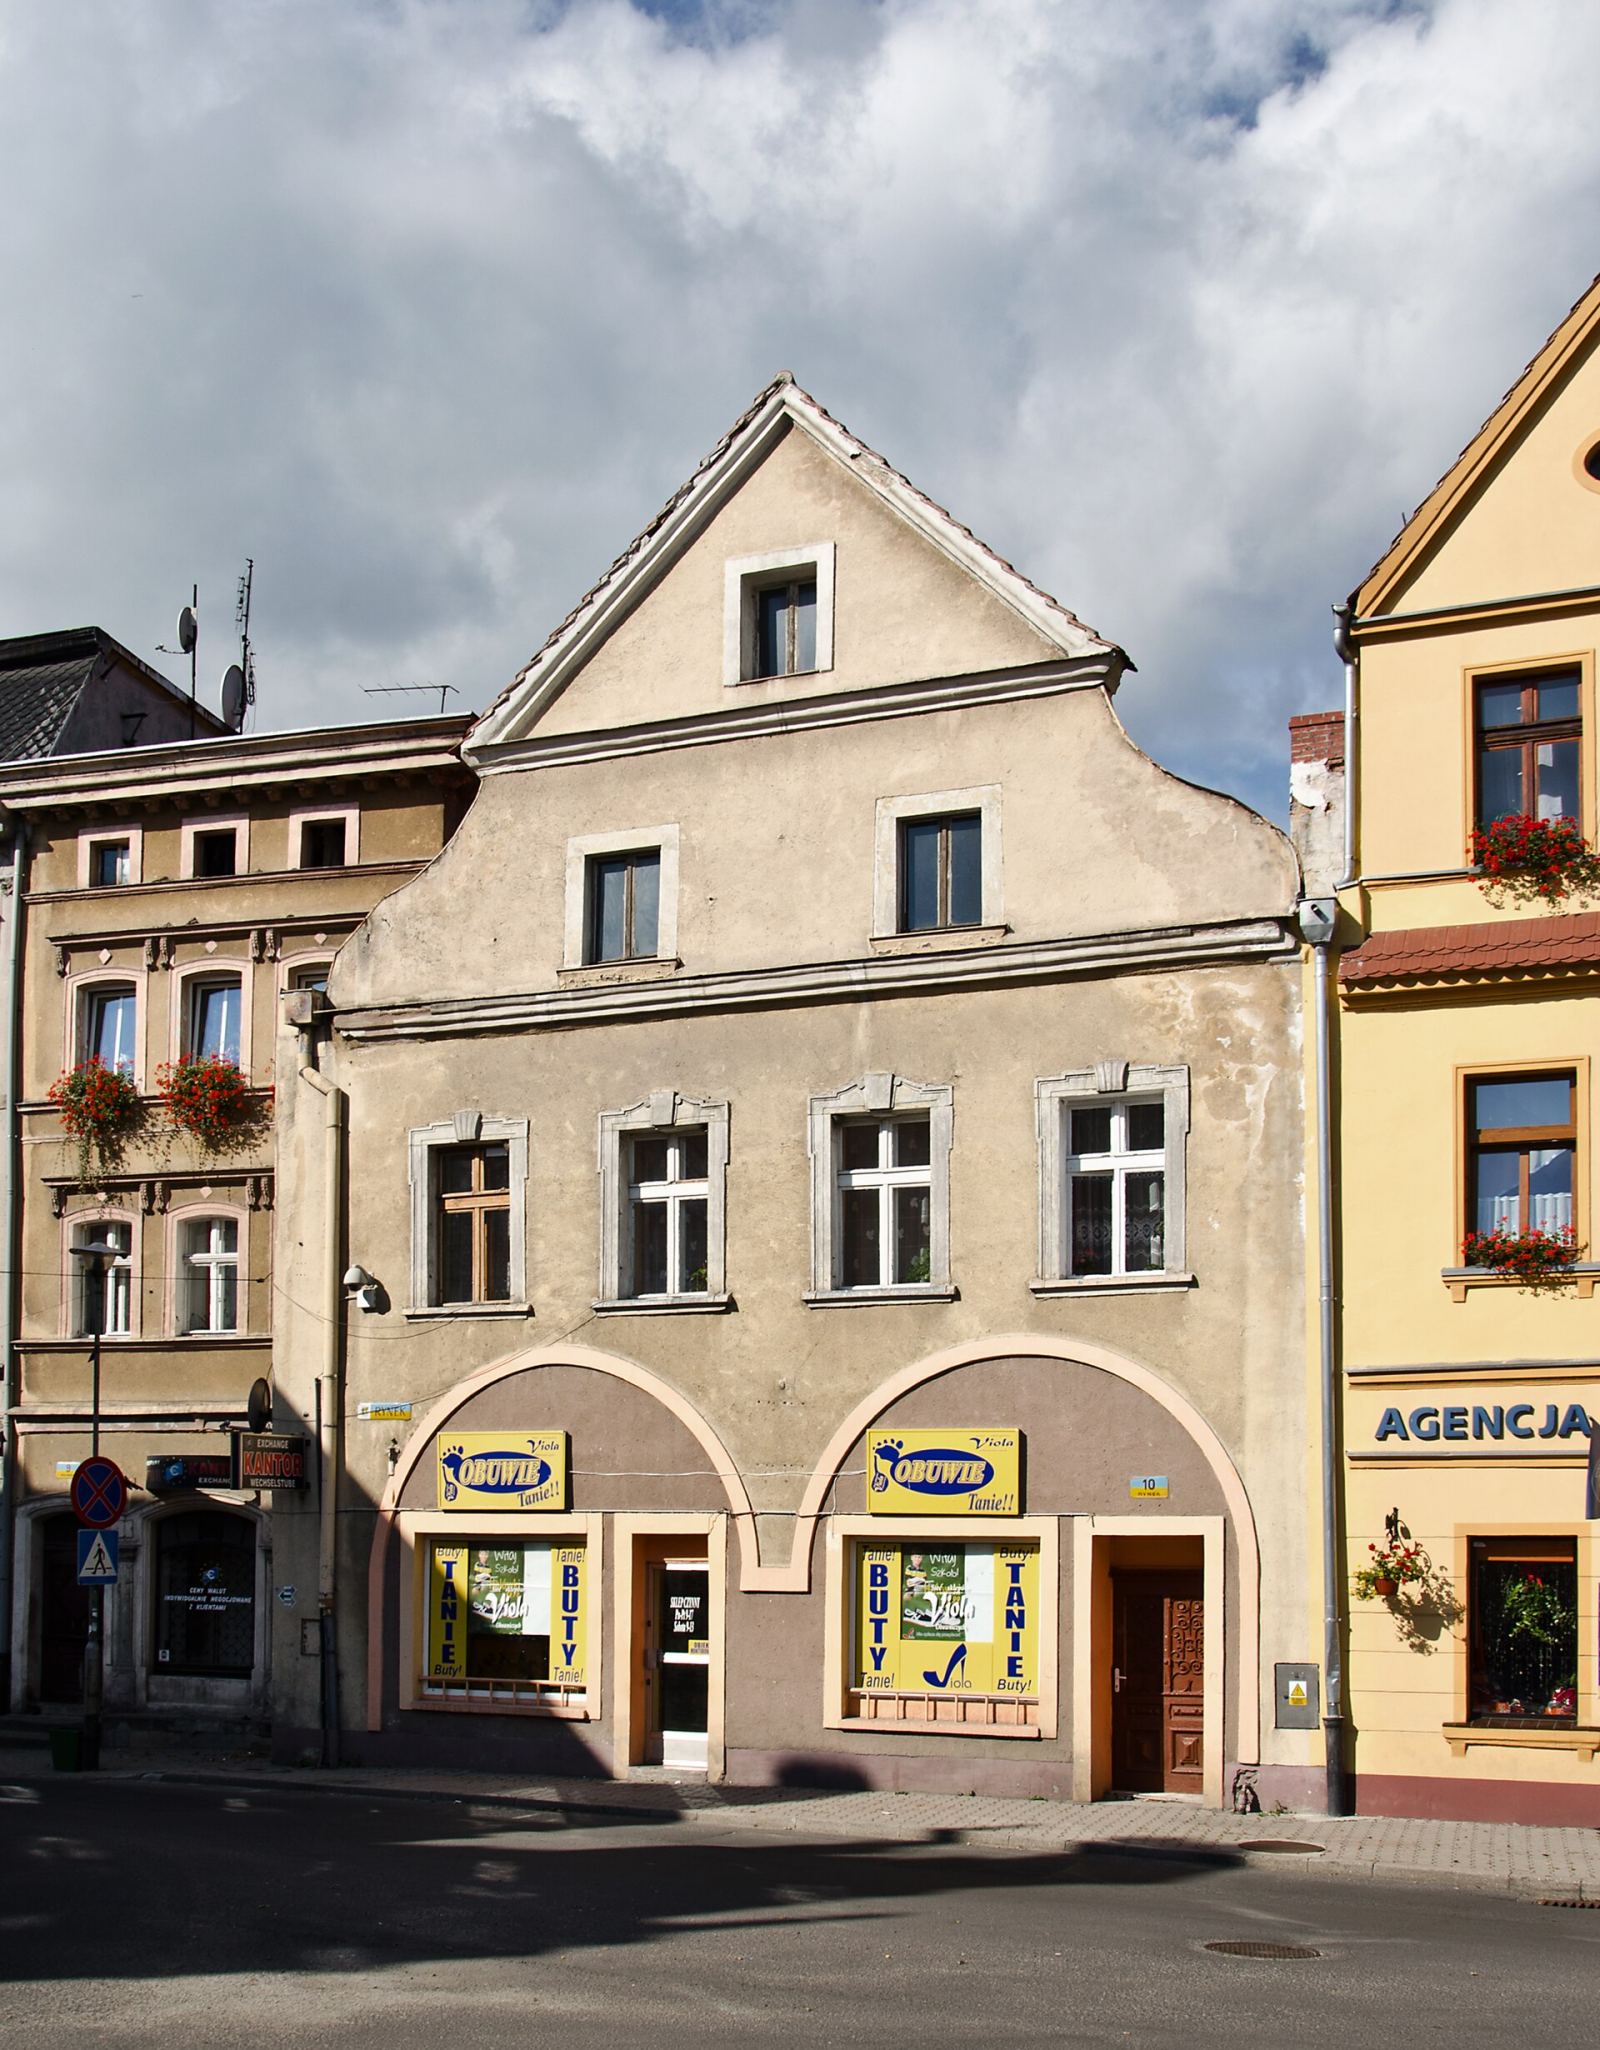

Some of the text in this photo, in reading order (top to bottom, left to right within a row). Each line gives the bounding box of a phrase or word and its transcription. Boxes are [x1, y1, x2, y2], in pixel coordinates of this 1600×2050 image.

[374, 1406, 407, 1417] RYNEK
[1375, 1404, 1592, 1440] AGENCJA
[257, 1439, 289, 1449] EXCHANGE
[527, 1440, 560, 1454] Viola
[969, 1437, 1014, 1450] Viola
[243, 1451, 303, 1477] KANTOR
[459, 1458, 541, 1486] OBUWIE
[894, 1459, 987, 1485] OBUWIE
[250, 1478, 296, 1488] WECHSELSTUBE
[1143, 1479, 1156, 1490] 10
[517, 1481, 560, 1507] Tanie!!
[968, 1493, 1014, 1511] Tanie!!
[436, 1547, 465, 1559] Buty!
[555, 1548, 585, 1562] Tanie!
[862, 1545, 897, 1562] Tanie!
[999, 1546, 1034, 1561] Buty!
[441, 1561, 458, 1664] TANIE
[485, 1591, 529, 1623] Viola
[562, 1565, 579, 1665] BUTY
[923, 1591, 976, 1625] Viola
[869, 1564, 889, 1671] BUTY
[1005, 1563, 1026, 1678] TANIE
[434, 1665, 462, 1677] Buty!
[554, 1667, 584, 1683] Tanie!
[860, 1672, 895, 1689] Tanie!
[997, 1679, 1032, 1694] Buty!
